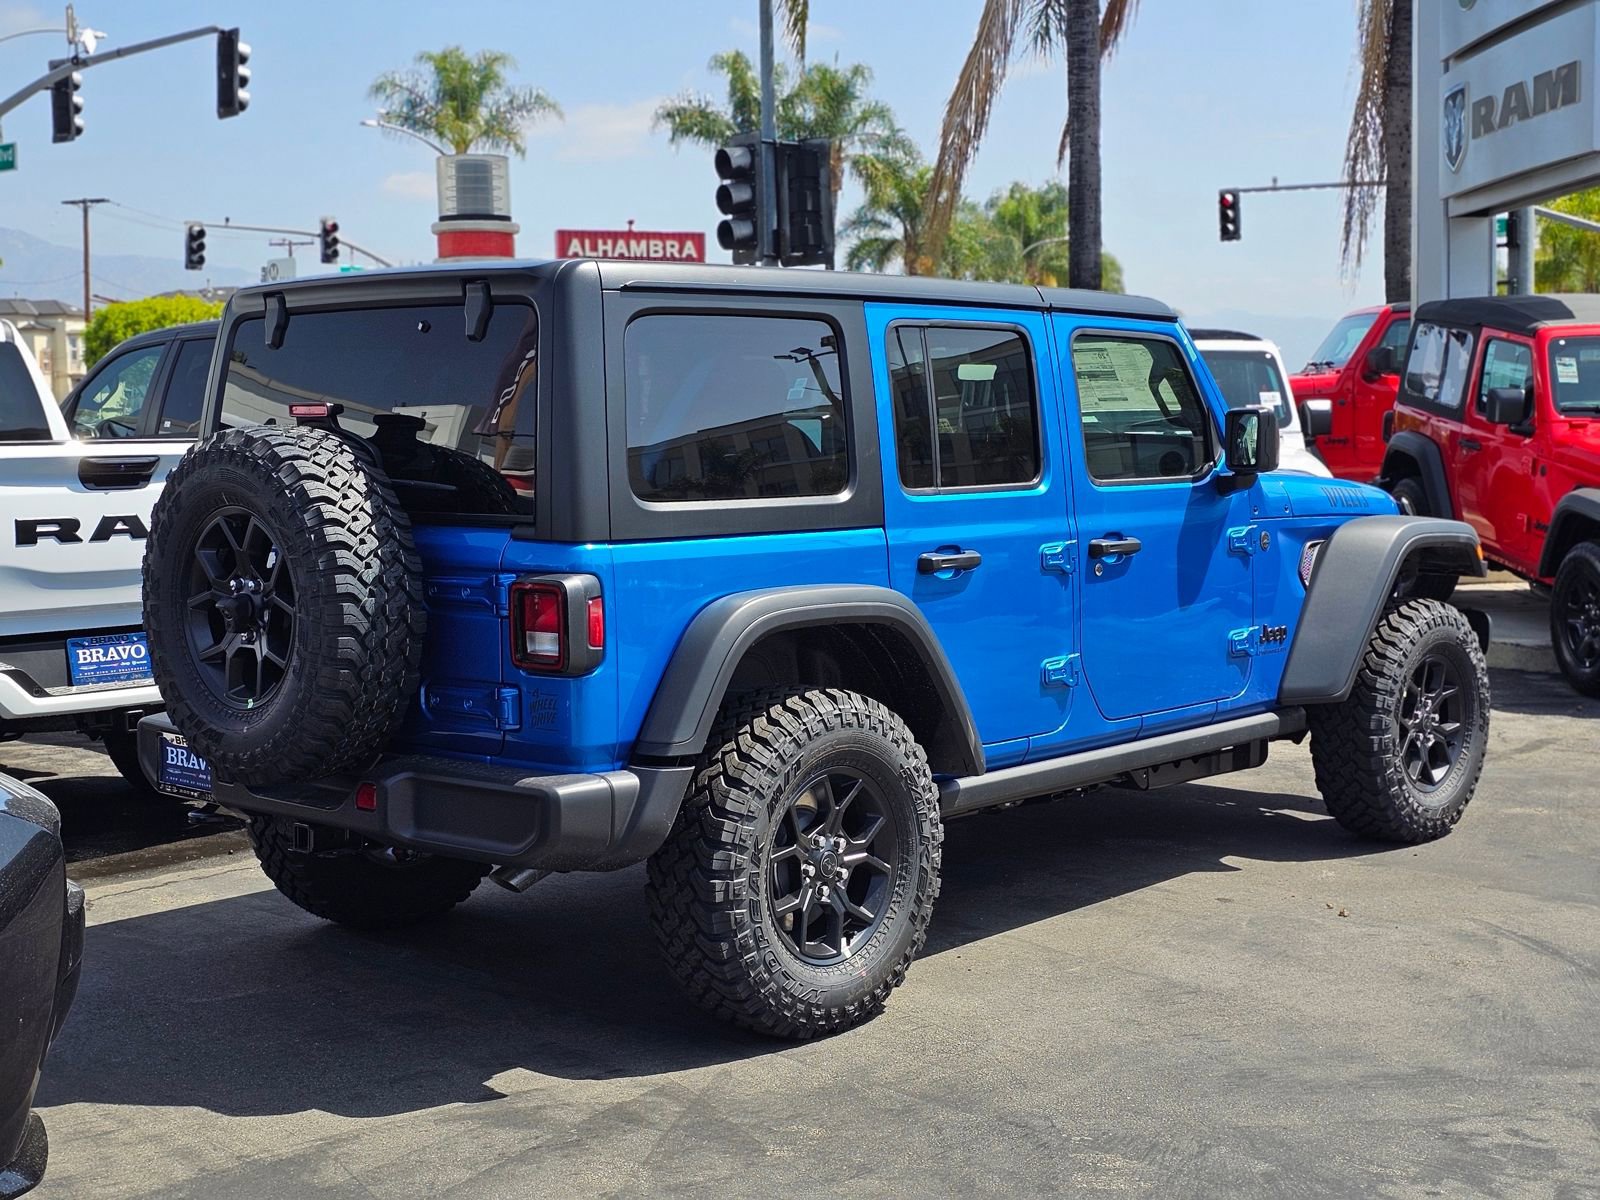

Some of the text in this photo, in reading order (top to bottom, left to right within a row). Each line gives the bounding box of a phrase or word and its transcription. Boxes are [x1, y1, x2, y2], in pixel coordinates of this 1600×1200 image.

[1472, 60, 1581, 140] RAM
[567, 238, 698, 258] ALHAMBRA
[15, 514, 150, 547] RA
[90, 634, 130, 645] BRAVO
[1259, 623, 1288, 645] Jeep
[76, 644, 146, 664] BRAVO
[529, 698, 558, 714] WHEEL
[530, 711, 558, 728] DRIVE
[166, 746, 210, 770] BRAV
[749, 834, 828, 1004] WILDPEAK
